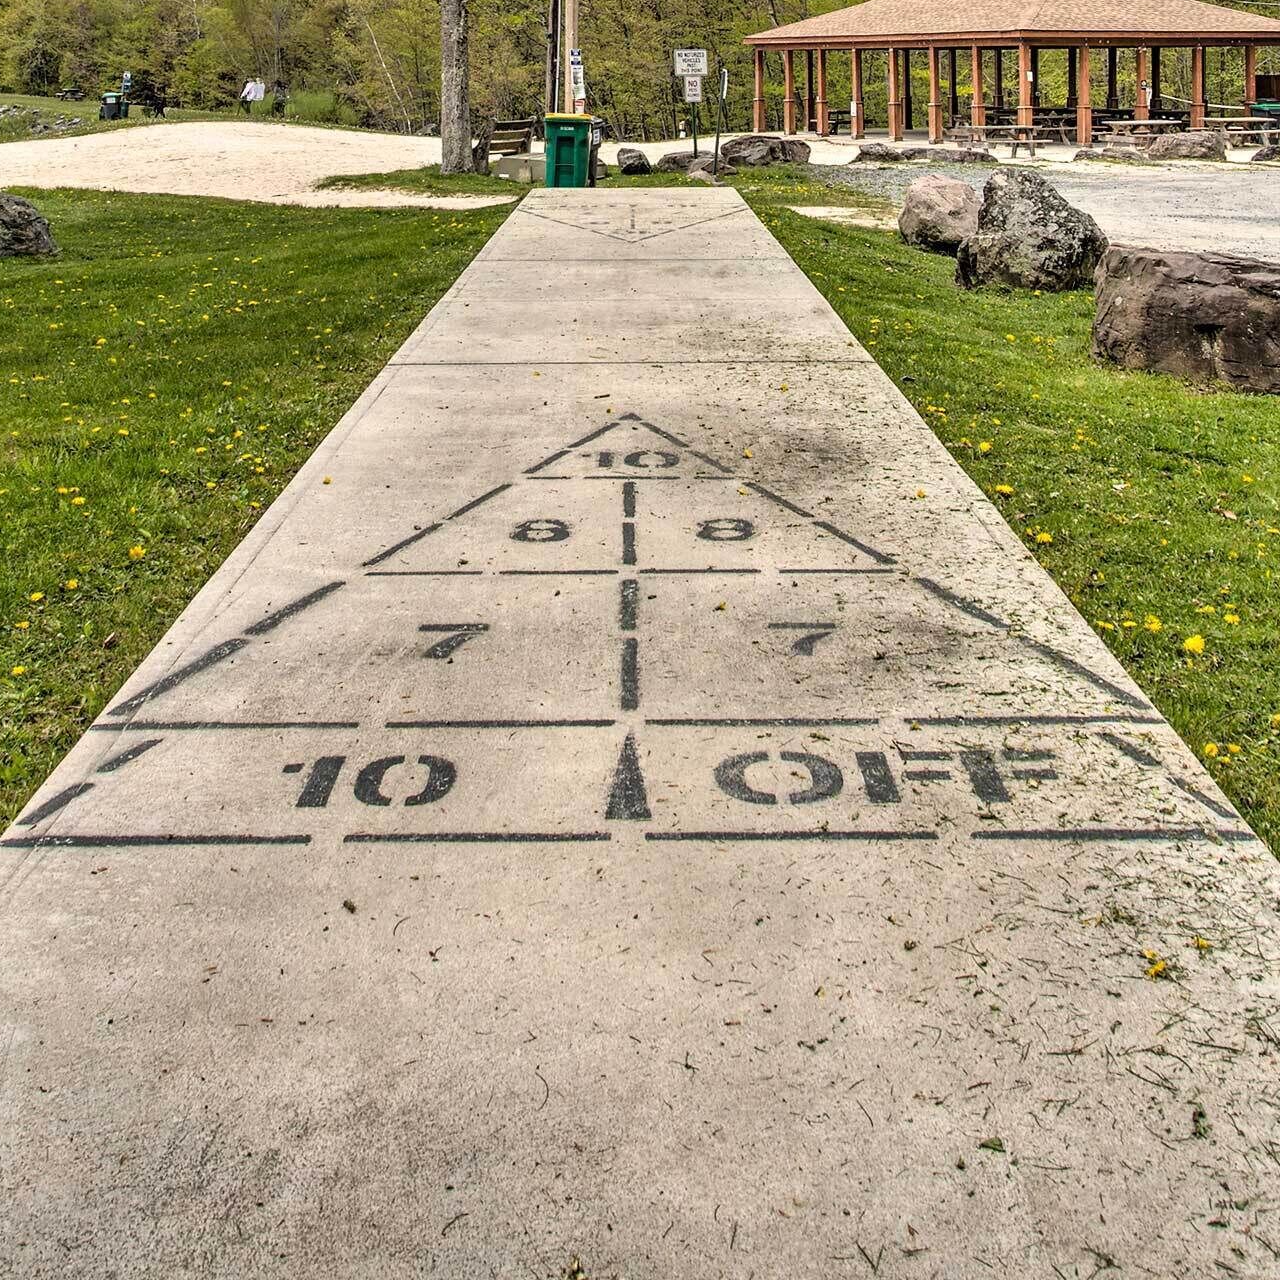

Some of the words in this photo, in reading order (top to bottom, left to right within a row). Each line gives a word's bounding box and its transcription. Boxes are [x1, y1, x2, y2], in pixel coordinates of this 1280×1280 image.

[582, 450, 680, 468] 10
[509, 518, 571, 542] 8
[696, 518, 755, 542] 8
[418, 623, 490, 660] 7
[768, 622, 836, 658] 7
[282, 754, 458, 808] 10
[714, 749, 1060, 807] OFF
